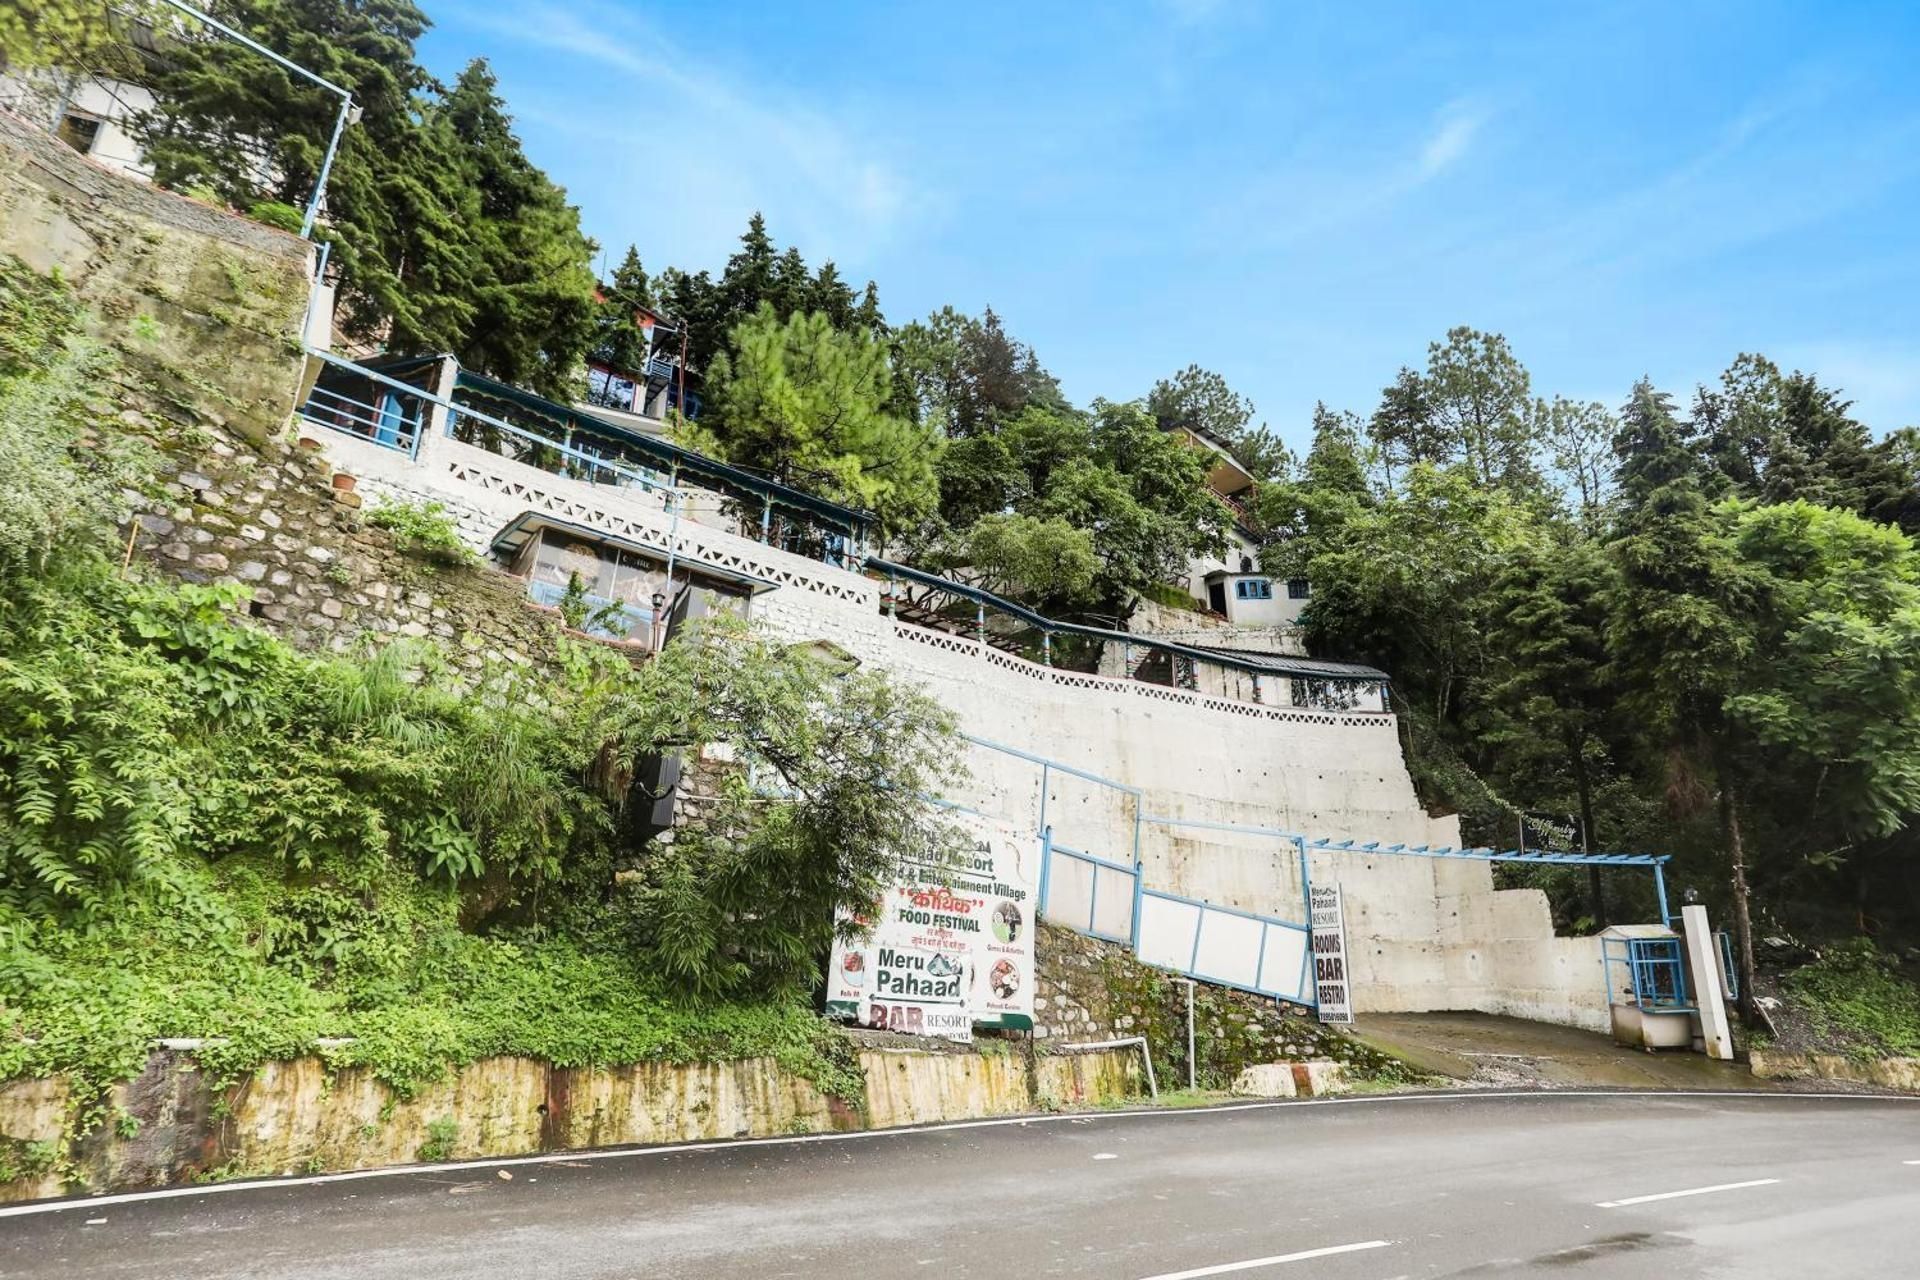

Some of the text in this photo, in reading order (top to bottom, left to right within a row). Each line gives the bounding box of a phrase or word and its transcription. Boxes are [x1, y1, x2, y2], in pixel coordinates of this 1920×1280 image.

[994, 882, 1026, 901] Village
[899, 908, 981, 932] FOOD FESTIVAL
[1314, 934, 1341, 954] ROOMS
[878, 949, 924, 971] Meru
[1316, 958, 1343, 981] BAR
[877, 970, 962, 998] Pahaad
[1318, 985, 1345, 1005] RESTRO
[869, 1004, 970, 1035] BAR RESORT
